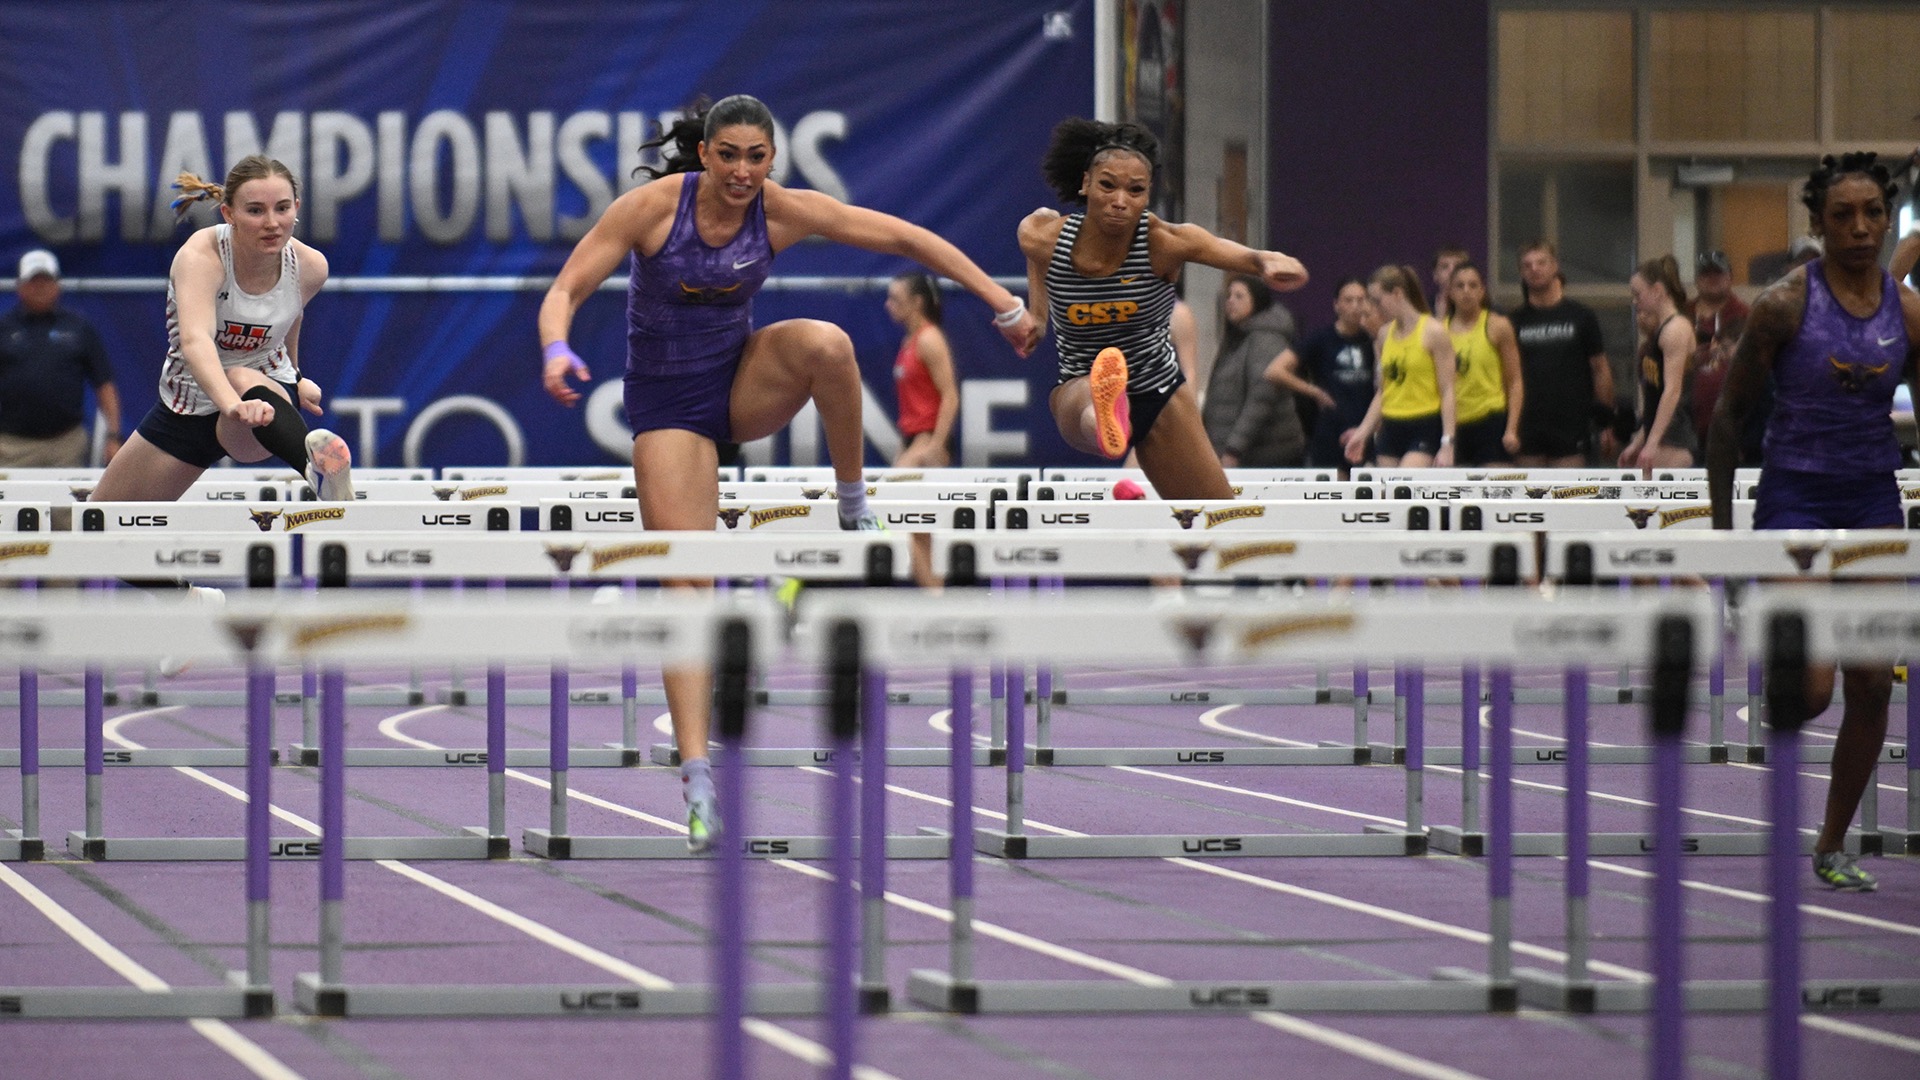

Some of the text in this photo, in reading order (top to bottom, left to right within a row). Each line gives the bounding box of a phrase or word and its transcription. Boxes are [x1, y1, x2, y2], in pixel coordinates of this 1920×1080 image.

[1067, 301, 1138, 325] CSP
[215, 330, 272, 350] MARY
[206, 491, 246, 500] UCS
[460, 486, 508, 500] MAVERICKS
[938, 492, 977, 500] UCS
[1065, 492, 1104, 500] UCS
[1422, 491, 1461, 499] UCS
[1551, 486, 1600, 499] MAVERICKS
[1660, 491, 1698, 499] UCS
[118, 515, 168, 526] UCS
[284, 508, 345, 531] MAVERICKS
[422, 514, 471, 525] UCS
[585, 511, 634, 522] UCS
[750, 505, 811, 529] MAVERICKS
[888, 513, 937, 524] UCS
[1041, 513, 1090, 524] UCS
[1205, 506, 1265, 529] MAVERICKS
[1341, 512, 1390, 523] UCS
[1496, 512, 1544, 523] UCS
[1659, 507, 1712, 529] MAVERICK
[155, 549, 222, 565] UCS
[366, 549, 433, 565] UCS
[775, 548, 842, 565] UCS
[994, 547, 1060, 564] UCS
[1400, 548, 1467, 565] UCS
[1609, 548, 1677, 566] UCS
[275, 695, 301, 703] CS
[569, 693, 609, 702] UCS
[887, 694, 910, 702] CS
[1170, 692, 1209, 701] UCS
[102, 752, 131, 763] CS
[1177, 752, 1224, 763] UCS
[1535, 751, 1568, 761] UC
[745, 842, 789, 853] CS
[1181, 838, 1243, 852] UCS
[1640, 838, 1698, 852] US
[560, 990, 640, 1010] UCS
[1189, 988, 1268, 1006] UCS
[1802, 987, 1880, 1006] UCS
